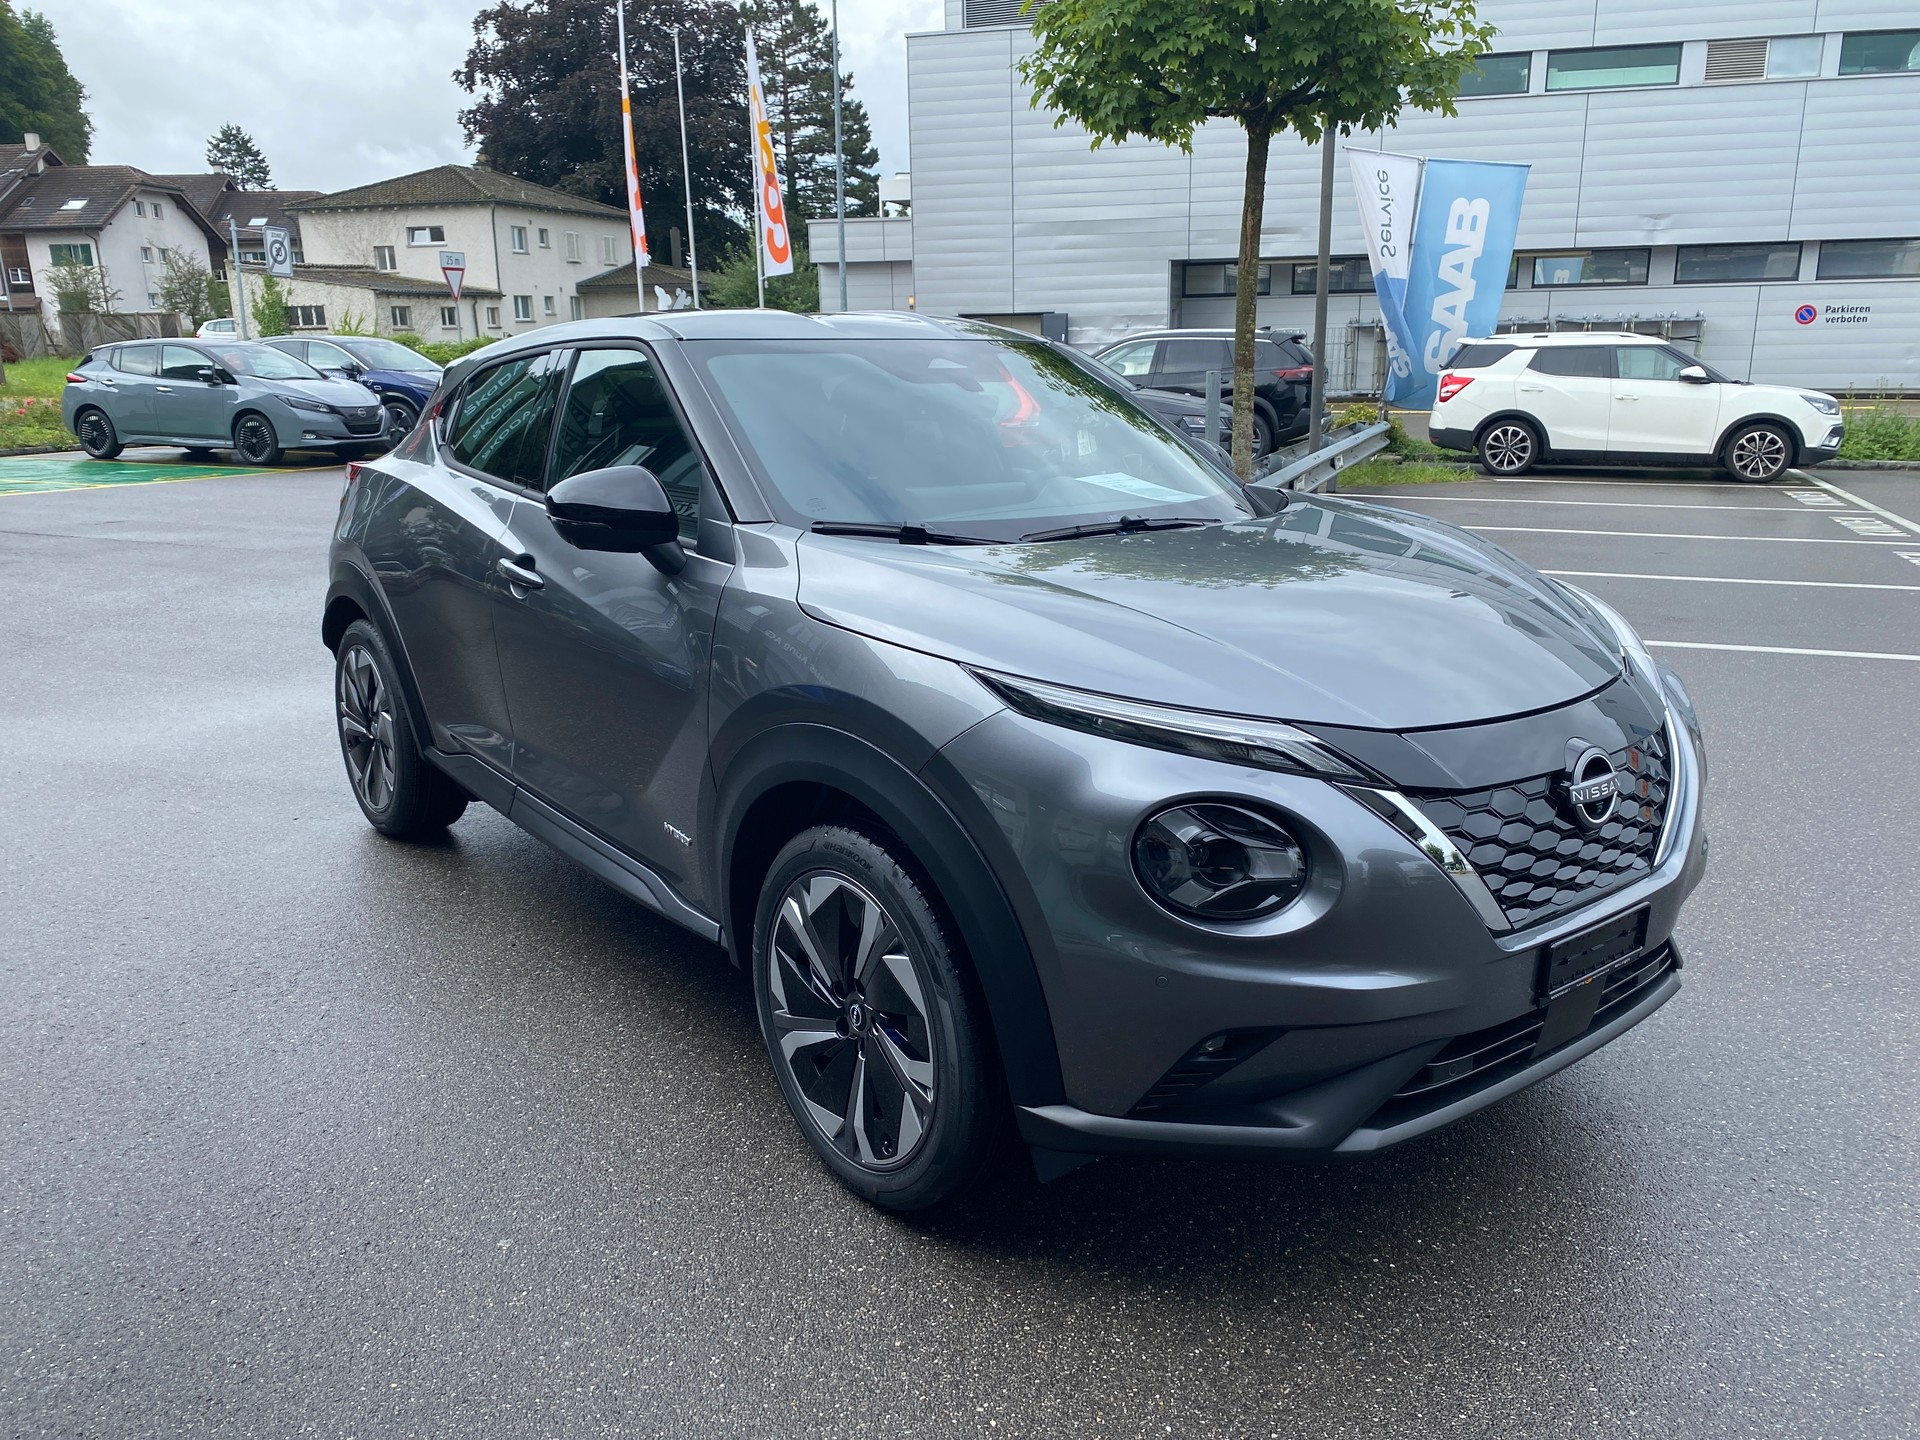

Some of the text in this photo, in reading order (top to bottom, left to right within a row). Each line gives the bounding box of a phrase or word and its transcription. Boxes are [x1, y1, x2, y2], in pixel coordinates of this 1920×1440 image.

[446, 255, 454, 265] 25
[1423, 197, 1490, 375] SAAB
[1825, 305, 1871, 313] Parkieren
[1825, 315, 1868, 323] verboten
